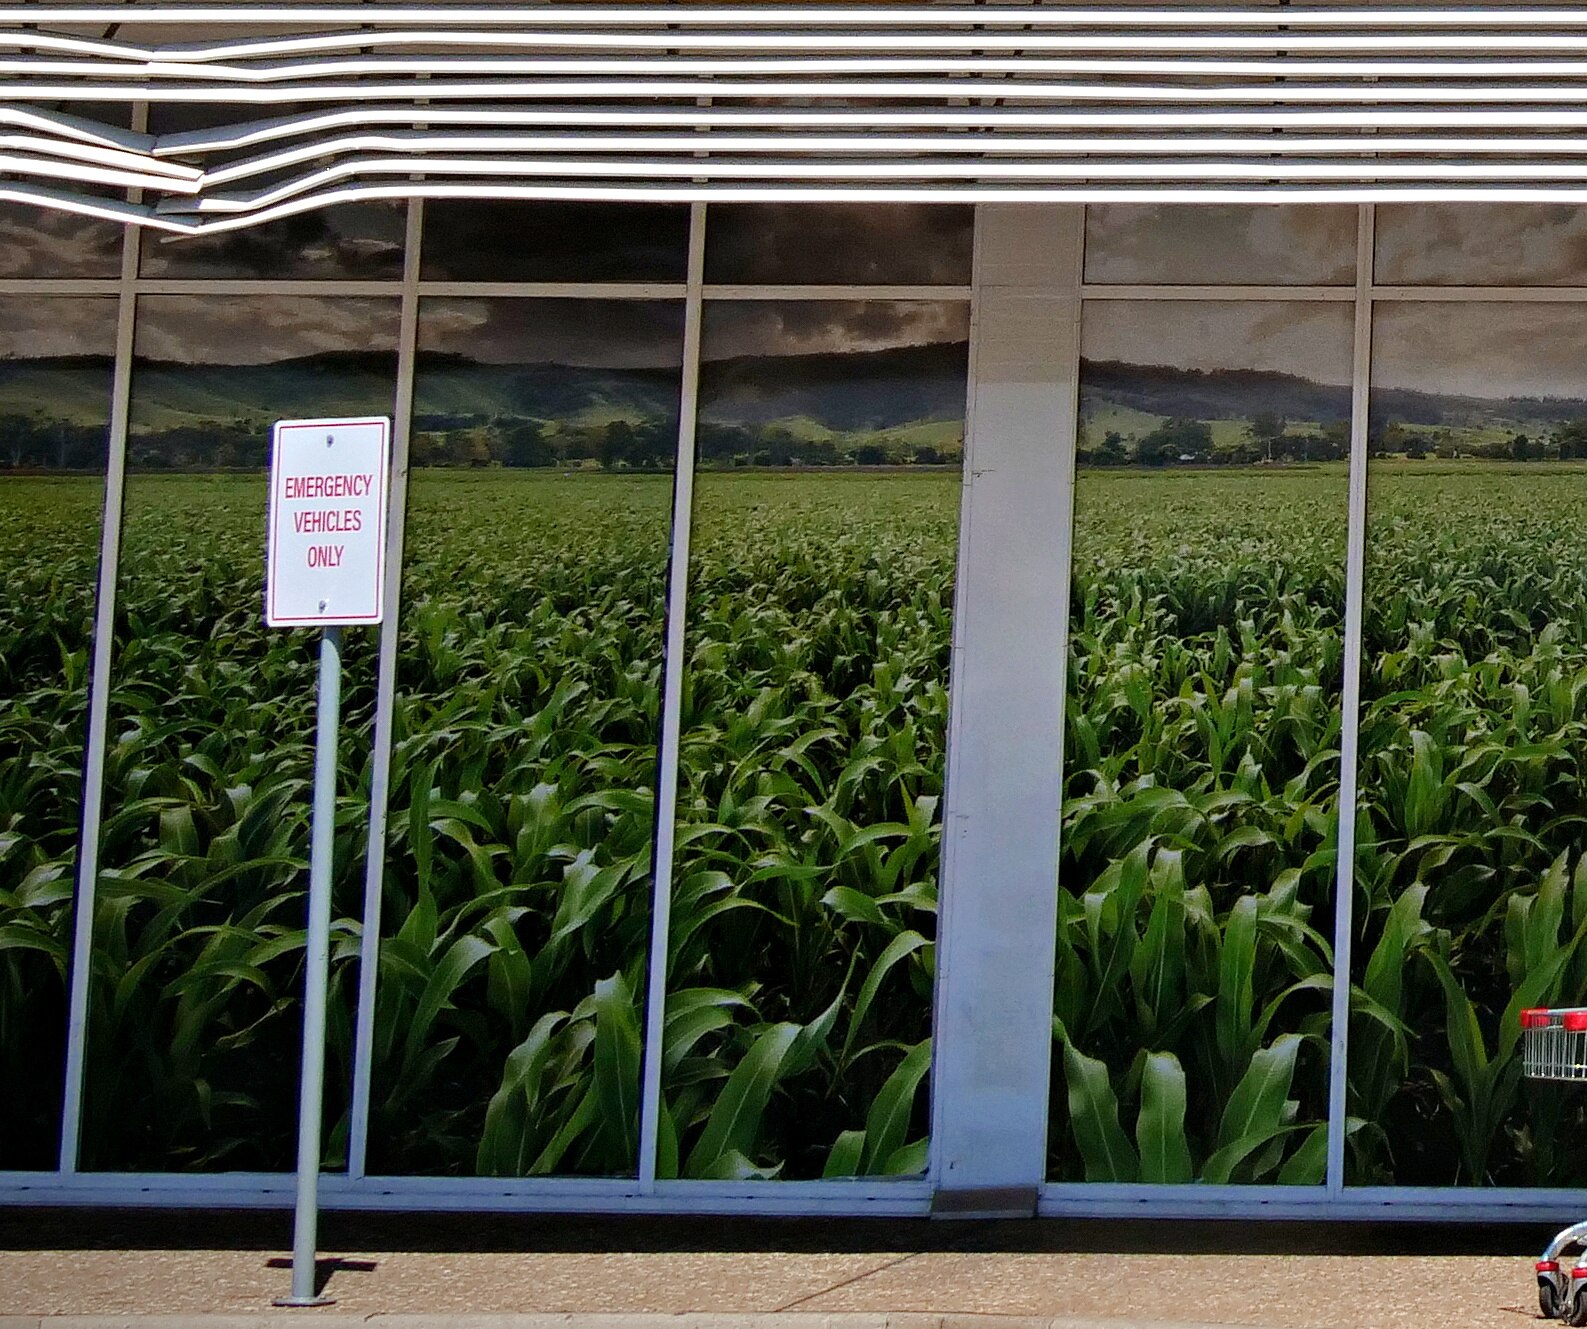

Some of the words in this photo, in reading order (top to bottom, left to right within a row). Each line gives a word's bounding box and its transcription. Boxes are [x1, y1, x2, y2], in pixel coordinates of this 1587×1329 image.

[285, 475, 373, 498] EMERGENCY
[294, 510, 362, 533] VEHICLES
[308, 545, 344, 568] ONLY
